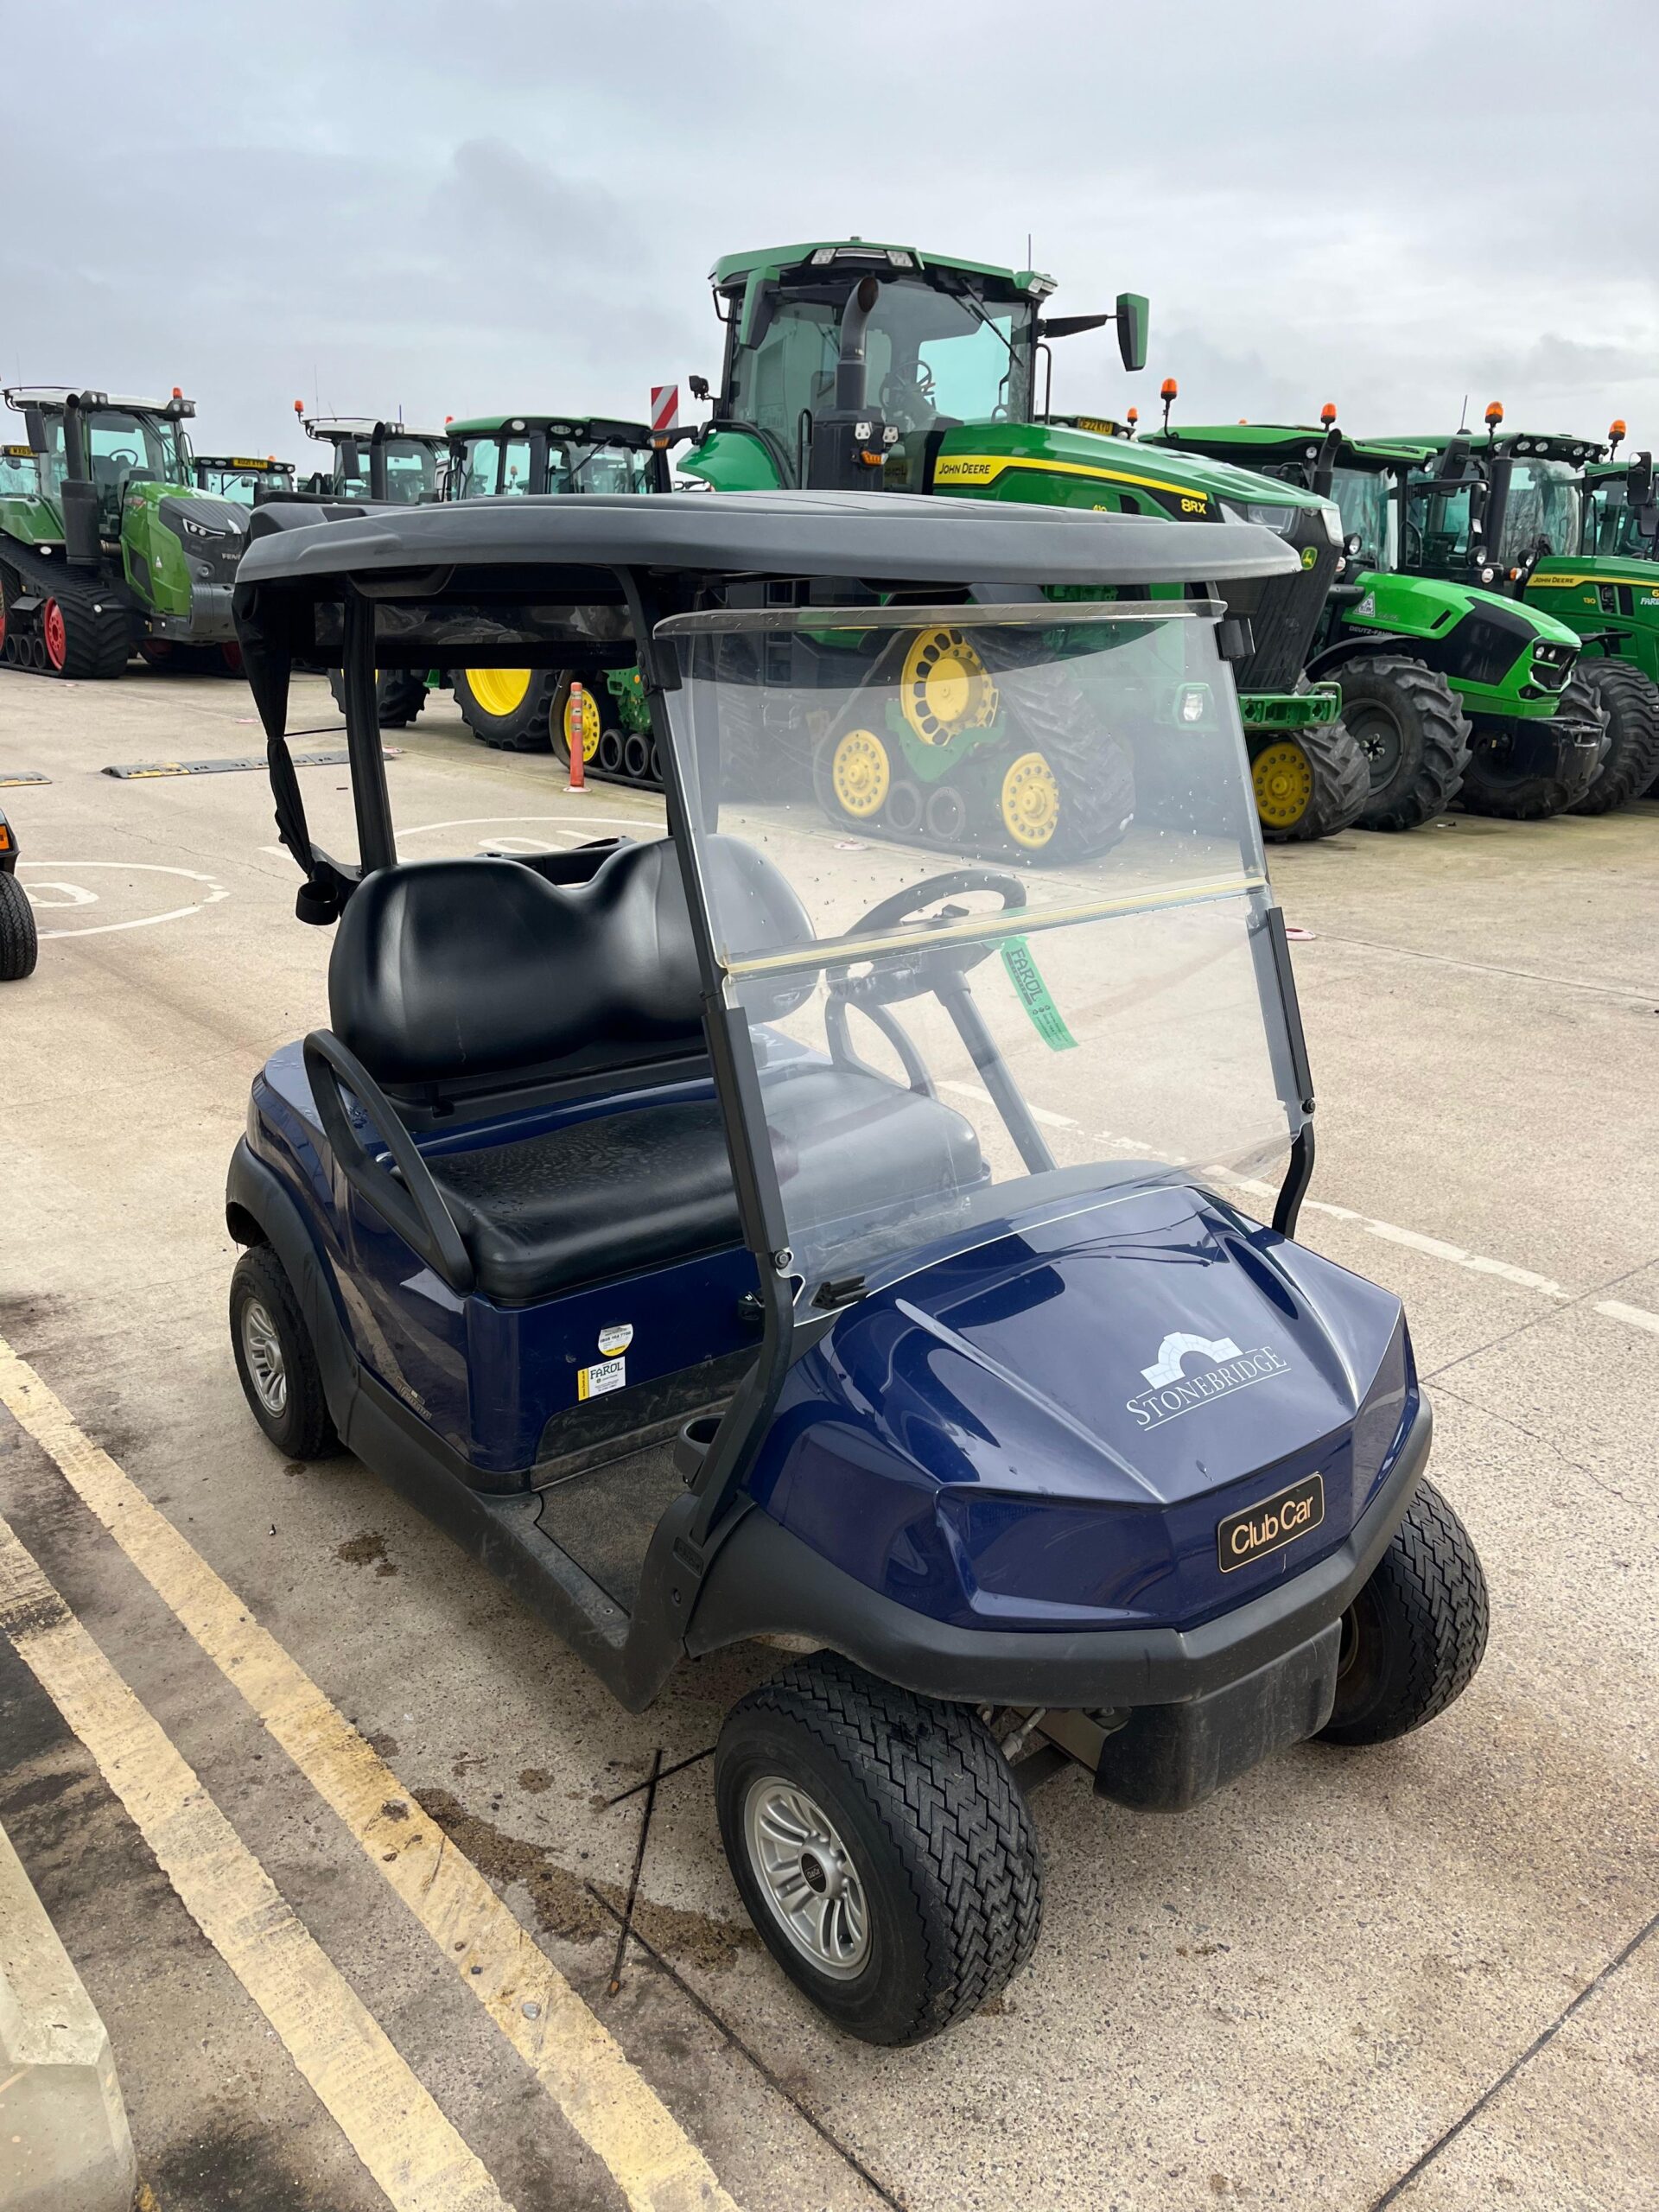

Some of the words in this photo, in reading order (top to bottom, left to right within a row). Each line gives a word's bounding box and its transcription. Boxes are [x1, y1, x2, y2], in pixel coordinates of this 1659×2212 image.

[938, 463, 961, 474] JOHN
[961, 462, 991, 474] DEERE
[1180, 498, 1207, 515] 8RX
[1011, 947, 1043, 1001] FAROL
[590, 1362, 623, 1379] FAROL
[1126, 1345, 1287, 1426] STONEBRIDGE
[1230, 1514, 1279, 1554] Club
[1280, 1496, 1314, 1530] Car
